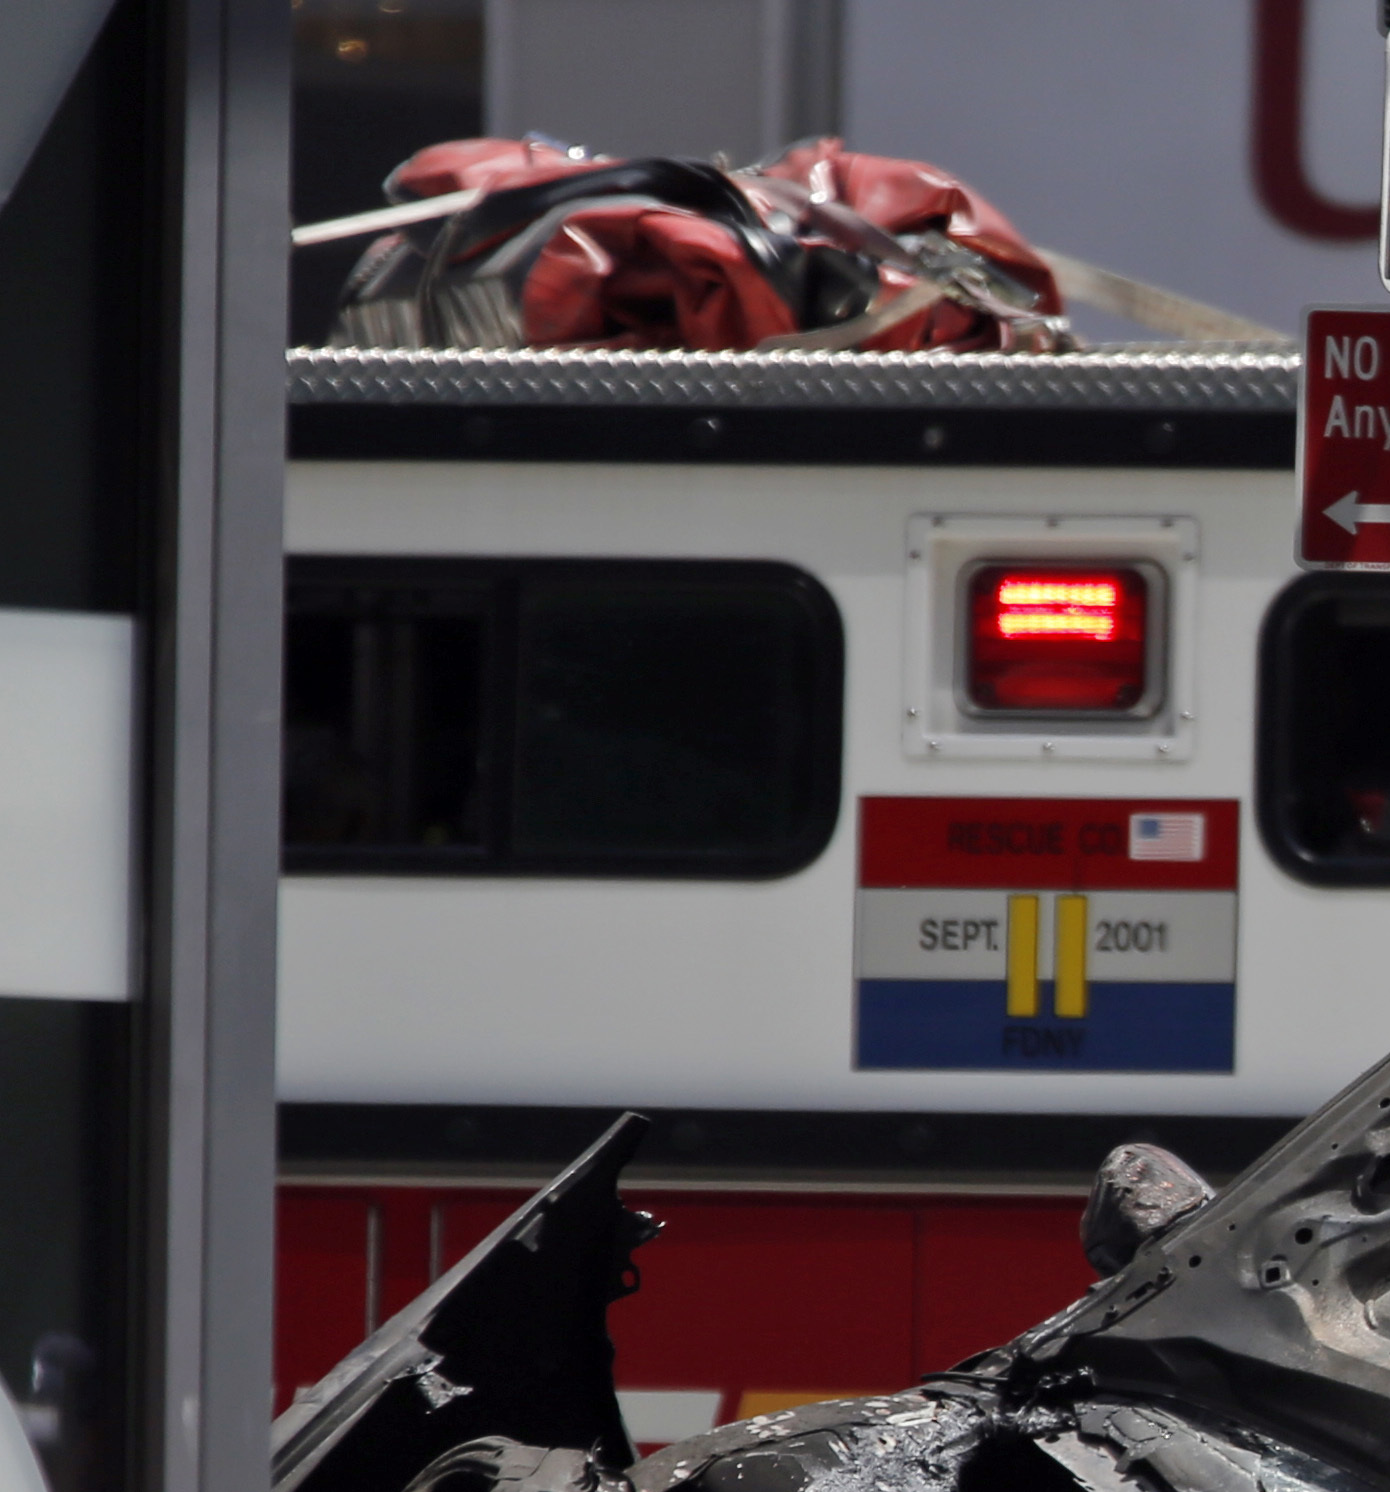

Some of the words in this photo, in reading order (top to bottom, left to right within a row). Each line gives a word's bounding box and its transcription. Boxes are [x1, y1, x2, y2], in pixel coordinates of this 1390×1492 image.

[1325, 335, 1380, 382] NO
[948, 822, 1066, 856] RESCUE
[919, 917, 999, 952] SEPT.
[1095, 920, 1169, 953] 2001
[1002, 1026, 1087, 1058] FDNY
